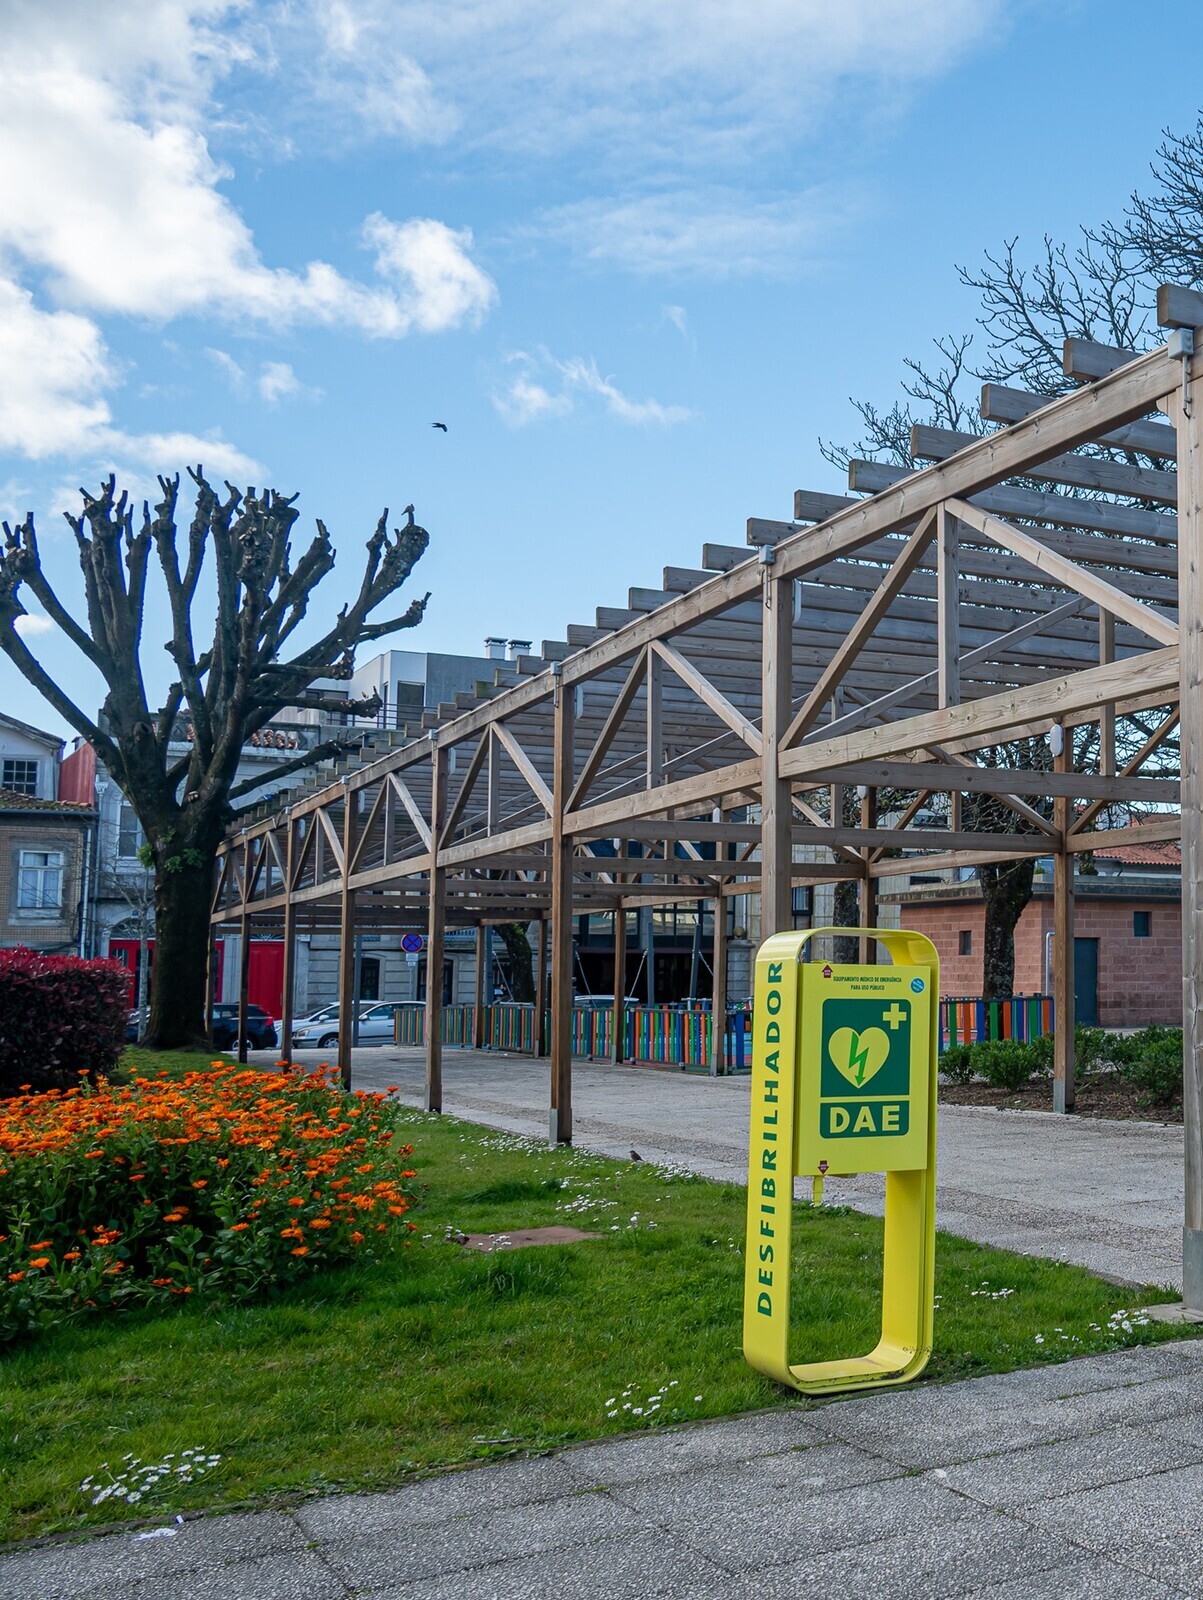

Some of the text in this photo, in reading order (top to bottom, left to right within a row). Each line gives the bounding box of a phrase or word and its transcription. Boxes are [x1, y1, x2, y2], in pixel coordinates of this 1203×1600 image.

[880, 975, 902, 983] EMERGÊNCIA
[829, 1104, 901, 1135] DAE
[757, 961, 783, 1317] DESFIBRILHADOR
